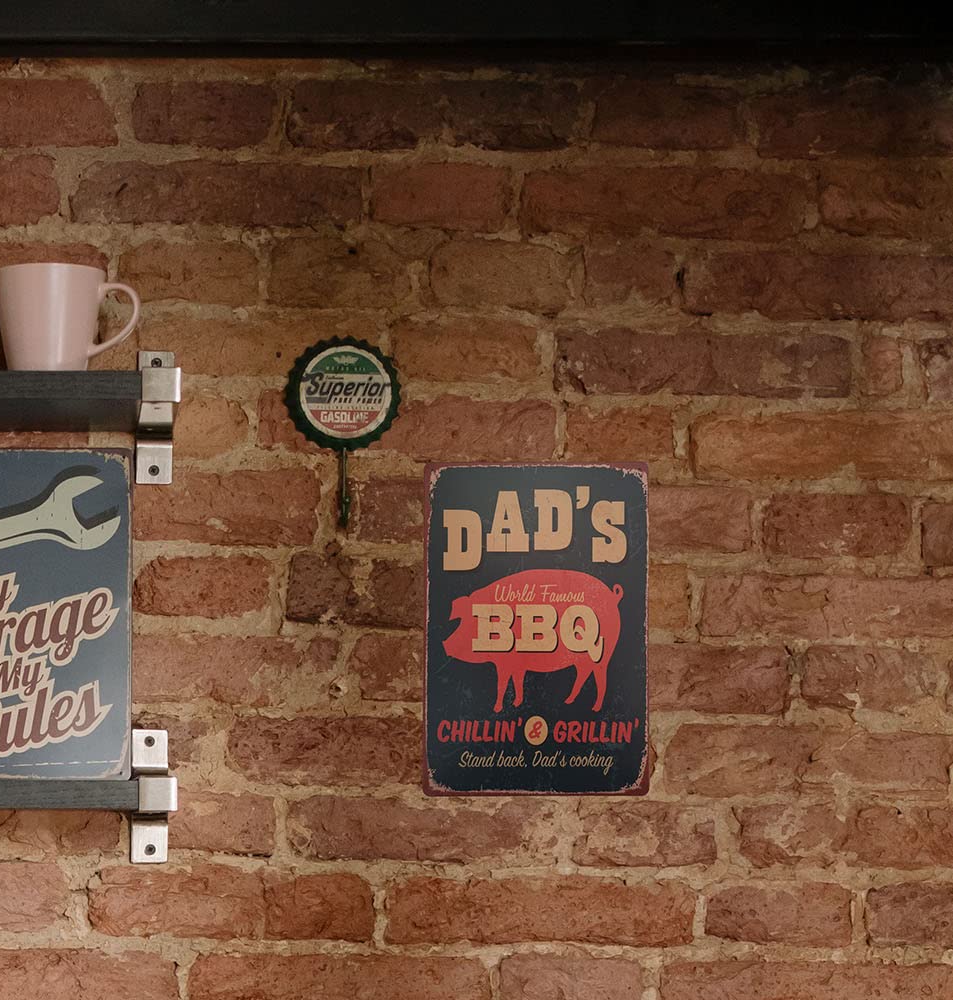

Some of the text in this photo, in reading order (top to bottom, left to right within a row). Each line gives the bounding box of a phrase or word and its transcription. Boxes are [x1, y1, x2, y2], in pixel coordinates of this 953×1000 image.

[301, 371, 391, 403] Superior
[442, 485, 627, 571] DAD'S
[494, 584, 585, 602] World Famous
[472, 604, 604, 663] BBQ
[437, 718, 640, 744] CHILLIN' & GRILLIN'
[458, 750, 496, 768] Stand
[532, 750, 567, 768] Dad's
[569, 753, 614, 776] cooking
